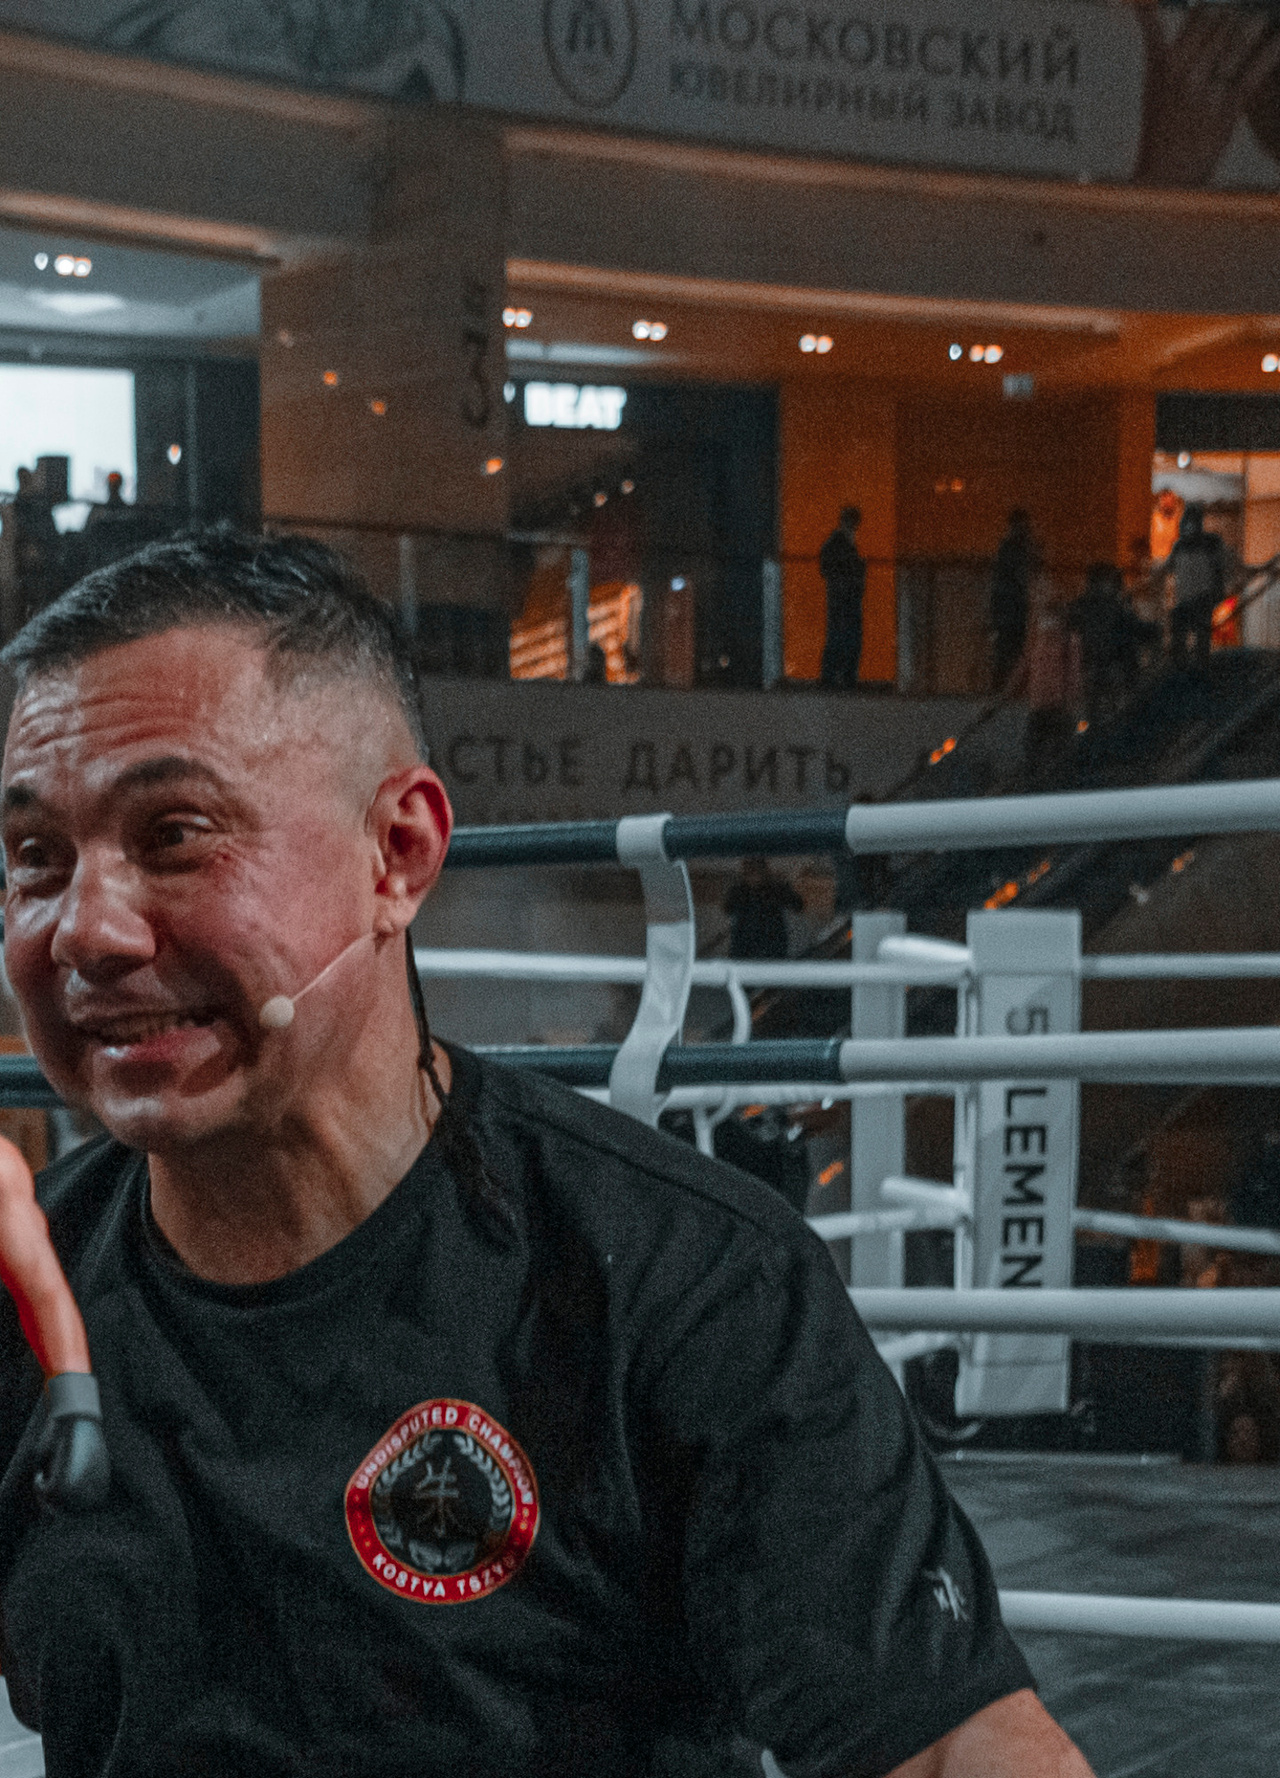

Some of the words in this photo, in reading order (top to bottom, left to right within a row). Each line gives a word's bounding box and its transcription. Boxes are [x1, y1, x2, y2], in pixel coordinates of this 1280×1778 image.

[671, 0, 1081, 88] МОСКОВСКИЙ
[669, 60, 929, 125] ЮВЕЛИРНЫЙ
[945, 90, 1077, 143] ЗАВОД
[442, 733, 583, 788] СТЬЕ
[621, 739, 855, 796] ДАРИТЬ
[999, 1006, 1051, 1290] 5LEMEN
[355, 1406, 459, 1490] UNDISPUTED
[468, 1413, 534, 1505] CHAMPION
[372, 1553, 446, 1598] KOSTYA
